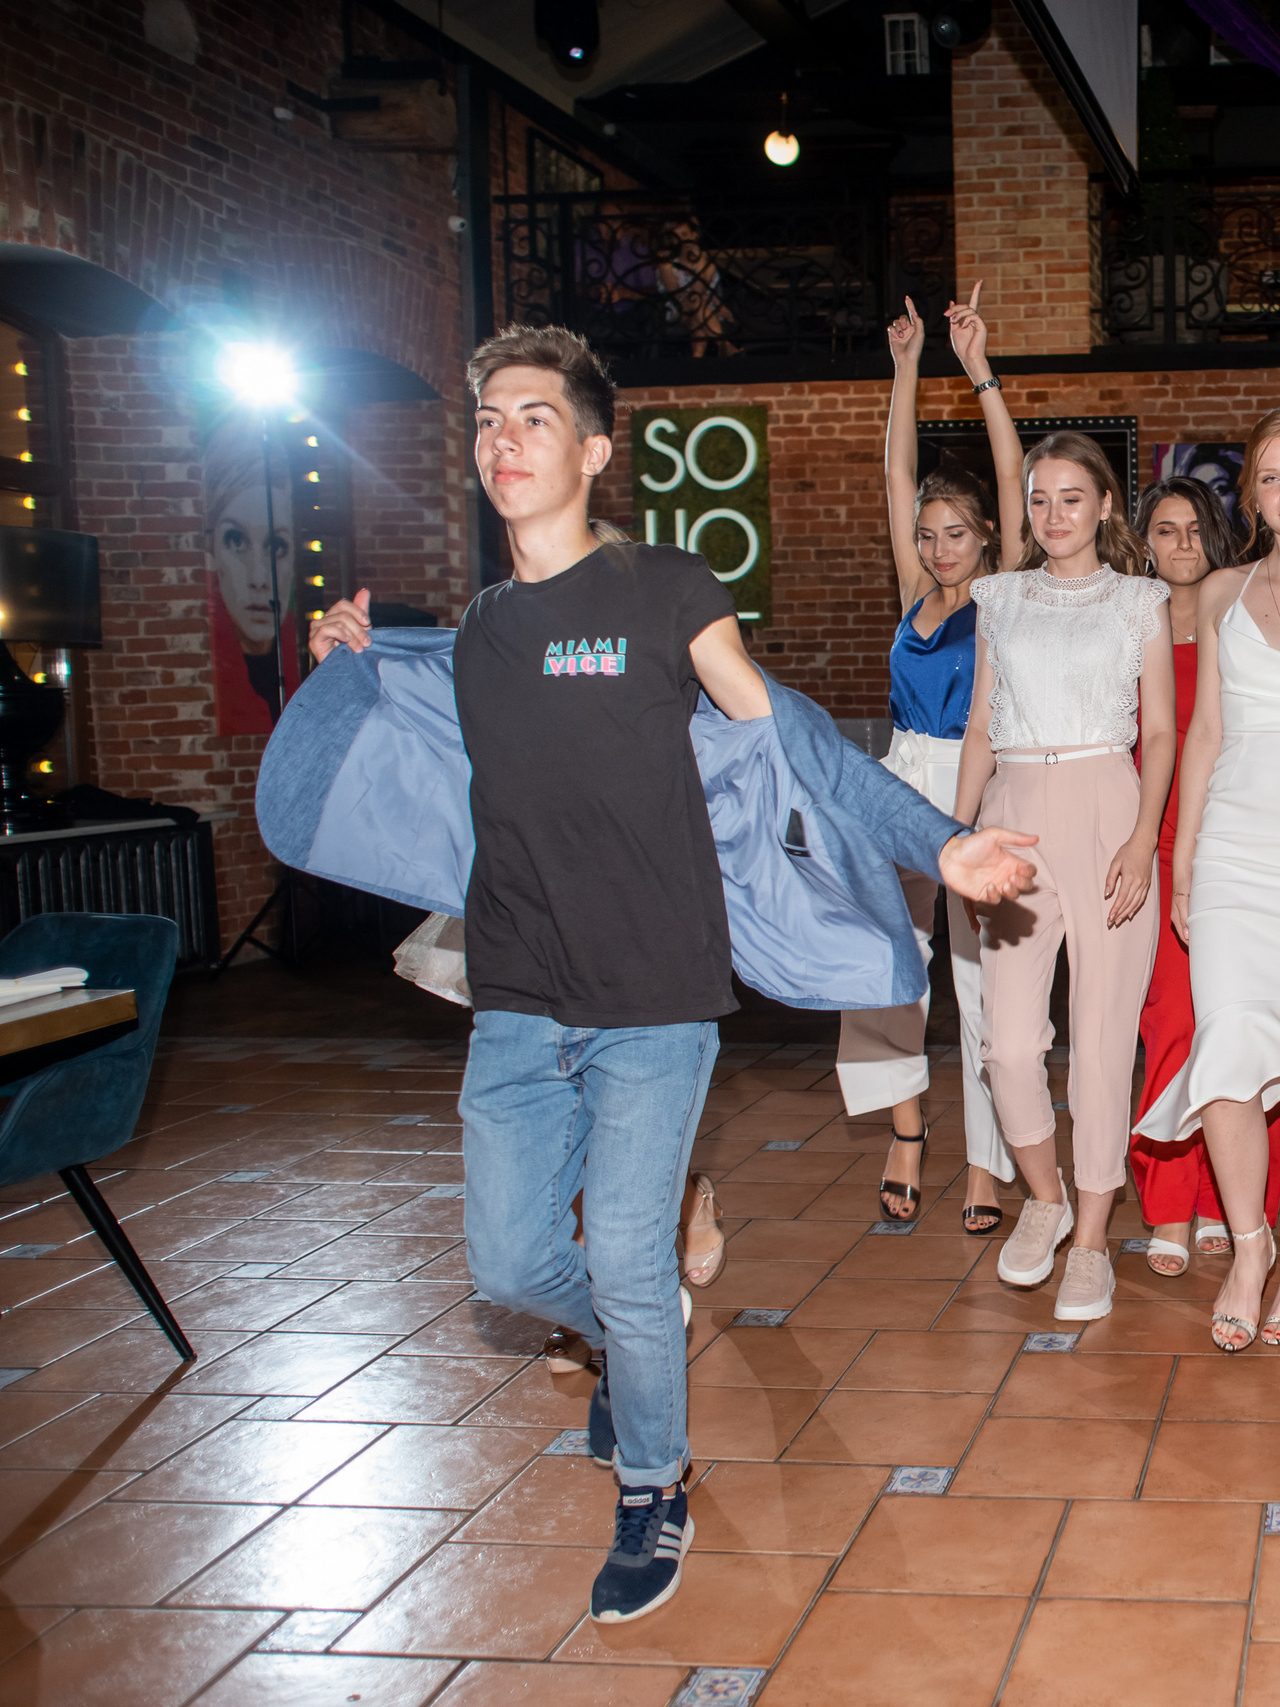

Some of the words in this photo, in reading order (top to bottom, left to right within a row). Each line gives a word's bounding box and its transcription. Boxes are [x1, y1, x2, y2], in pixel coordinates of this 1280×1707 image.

[640, 416, 757, 492] SO
[545, 637, 627, 656] MIAMI
[547, 656, 620, 677] VICE
[627, 1496, 650, 1504] adidas
